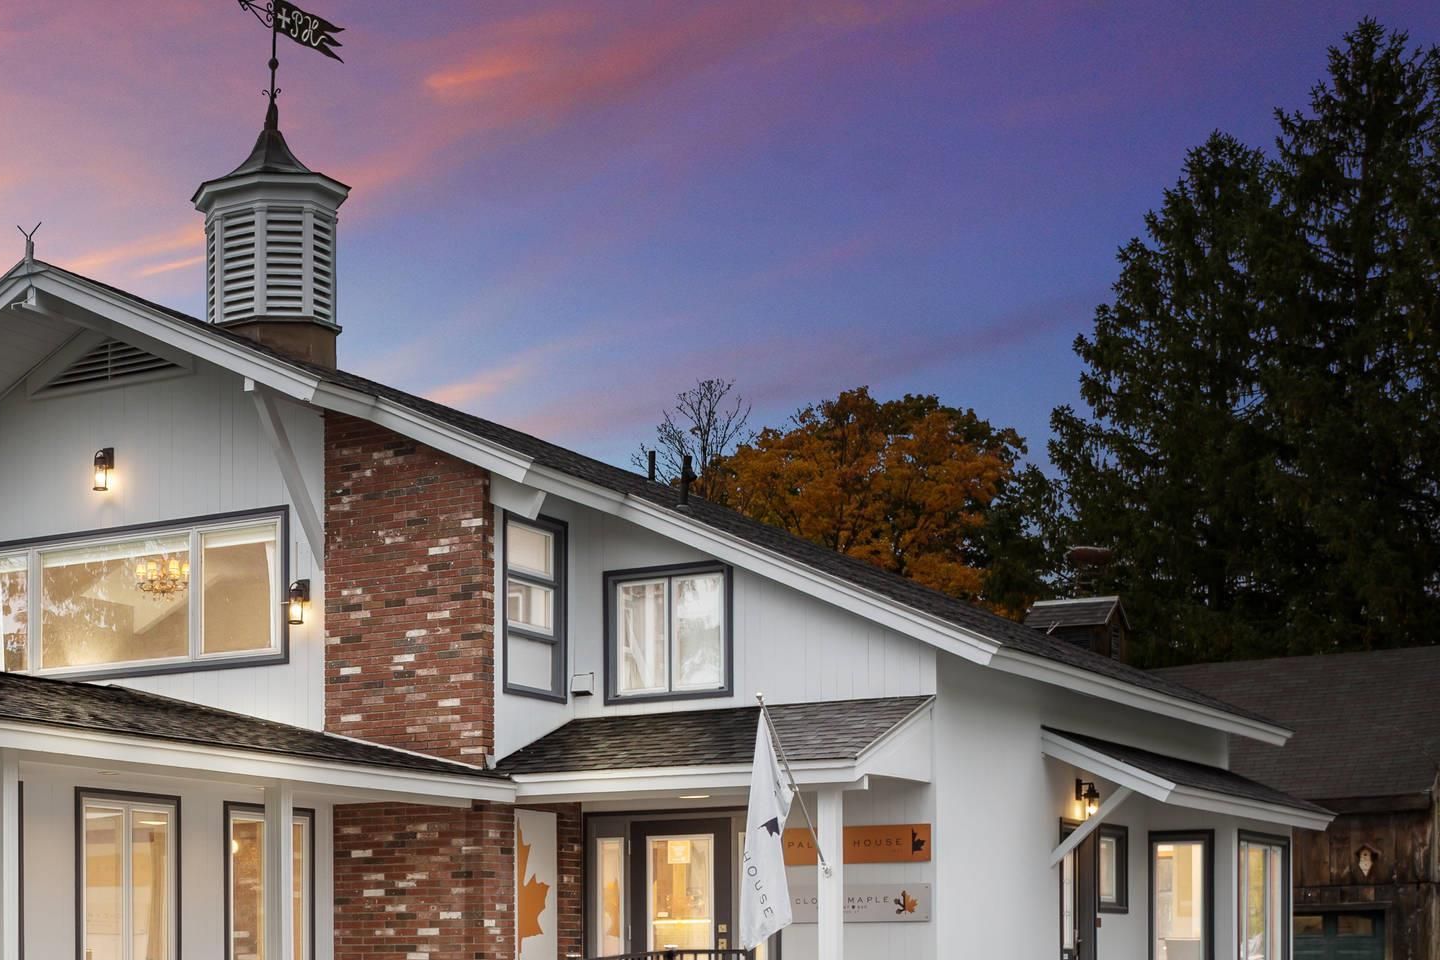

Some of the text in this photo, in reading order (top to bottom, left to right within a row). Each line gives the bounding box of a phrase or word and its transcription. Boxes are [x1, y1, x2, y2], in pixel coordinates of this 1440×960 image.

[787, 838, 903, 850] PAL HOUSE
[743, 851, 774, 918] HOUSE
[847, 896, 890, 904] MAPLE
